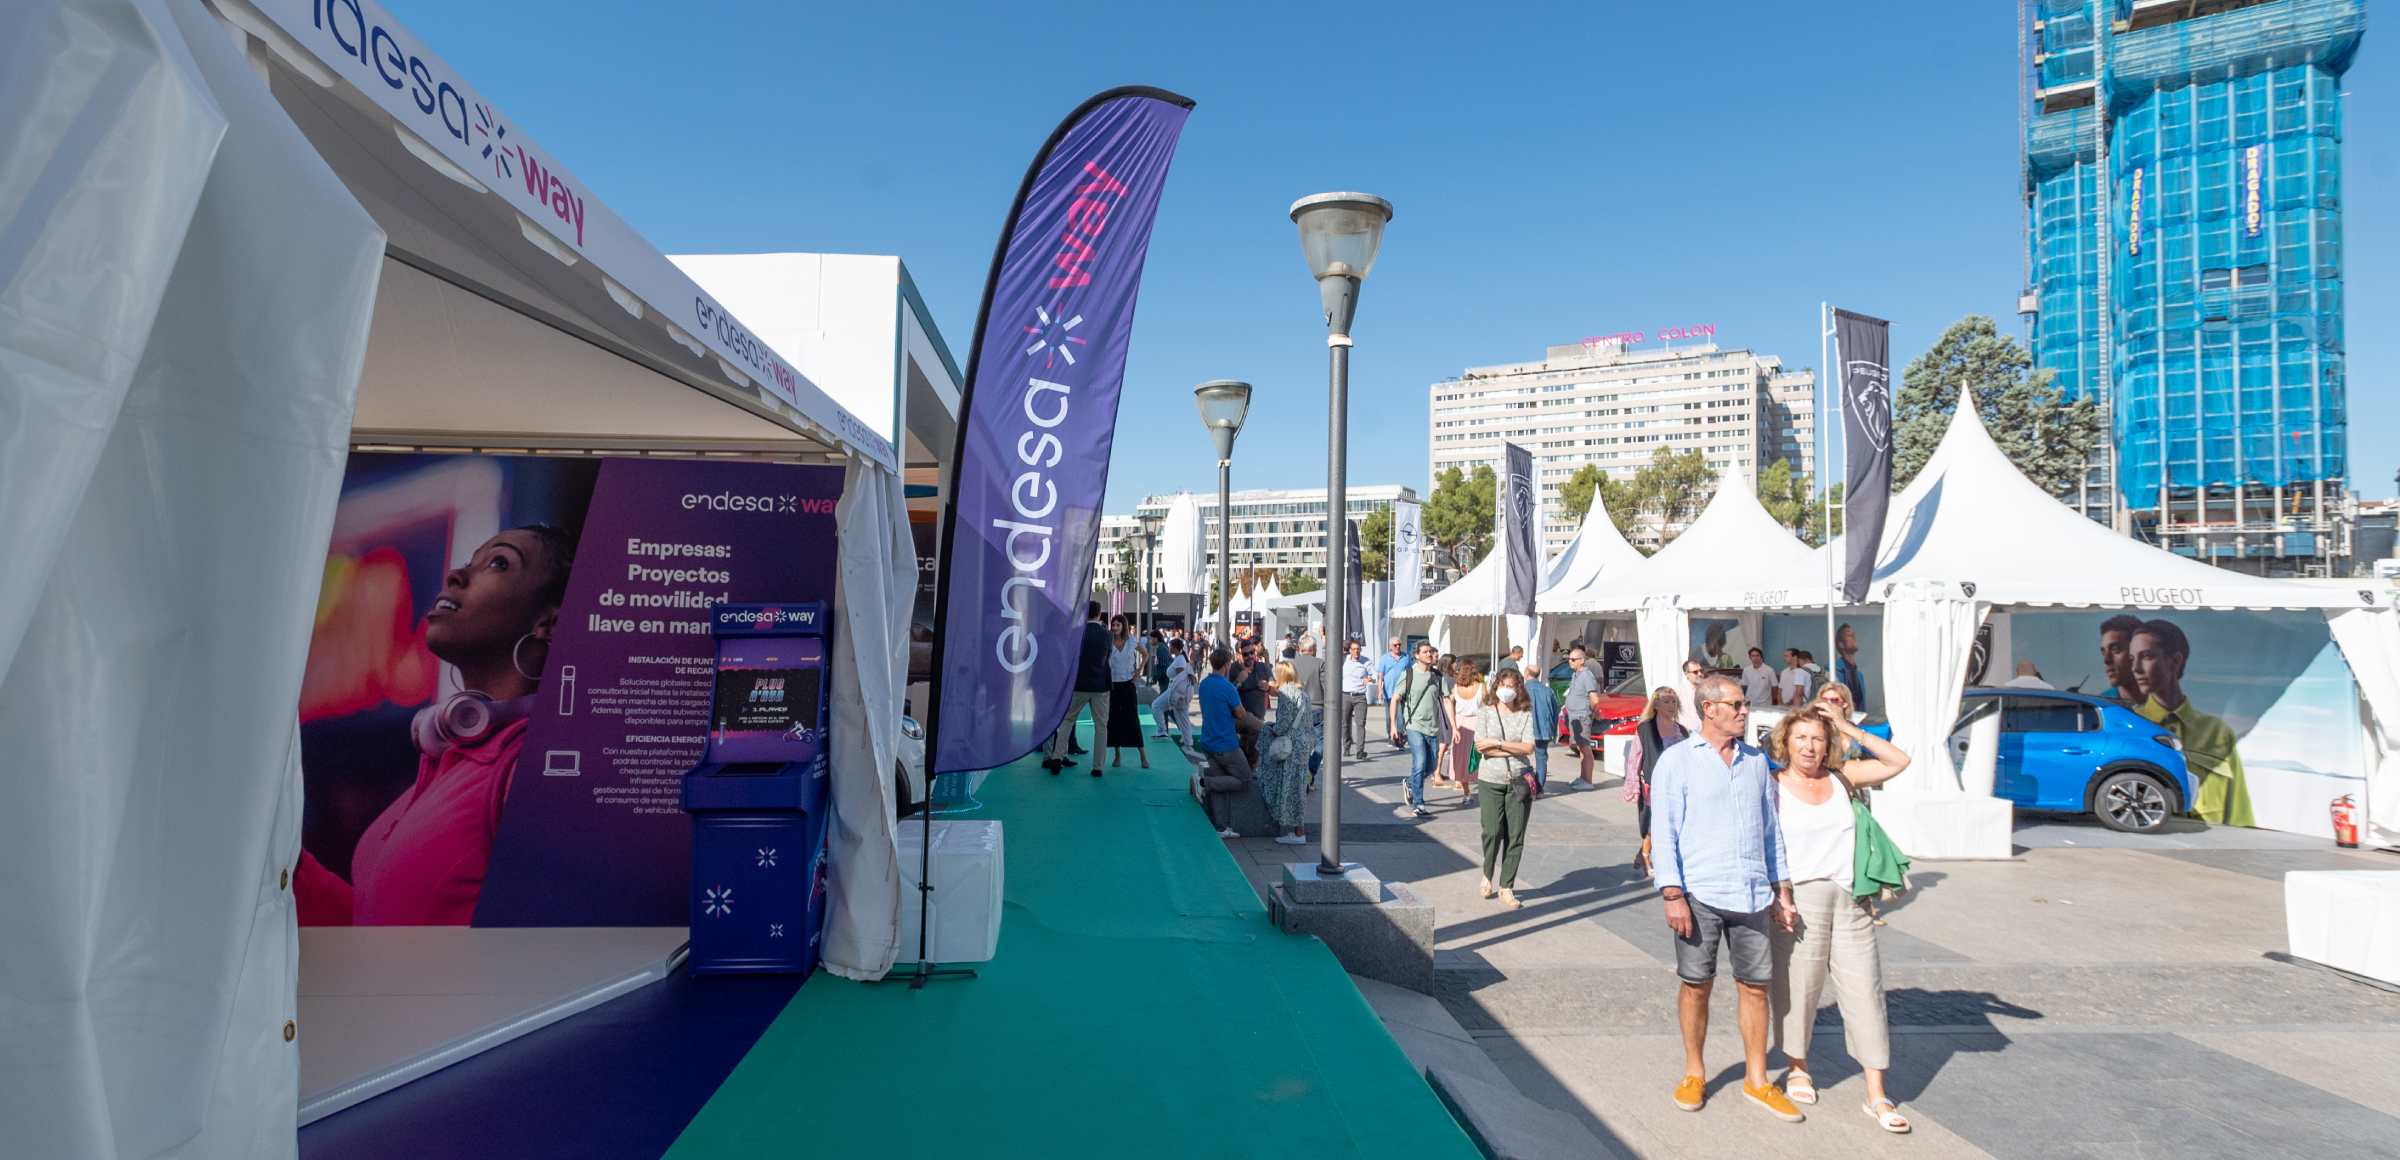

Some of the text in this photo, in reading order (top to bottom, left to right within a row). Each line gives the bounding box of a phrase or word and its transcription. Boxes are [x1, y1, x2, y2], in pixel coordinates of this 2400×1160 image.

[516, 143, 584, 248] way
[695, 296, 798, 405] endesa way
[993, 160, 1129, 674] endesa way
[681, 491, 837, 514] endesa wa
[627, 538, 732, 560] Empresas:
[627, 564, 730, 585] Proyectos
[599, 589, 626, 607] de
[1744, 590, 1790, 605] PEUGEOT
[2120, 586, 2204, 604] PEUGEOT
[588, 614, 712, 635] llave en man
[720, 609, 815, 625] endesa way
[628, 655, 680, 664] INSTALACIÓN
[682, 657, 692, 665] DE
[693, 657, 714, 666] PUNT
[687, 667, 714, 675] RECAR
[680, 700, 711, 708] cargado
[626, 735, 707, 744] EFICIENCIA ENERGÉT
